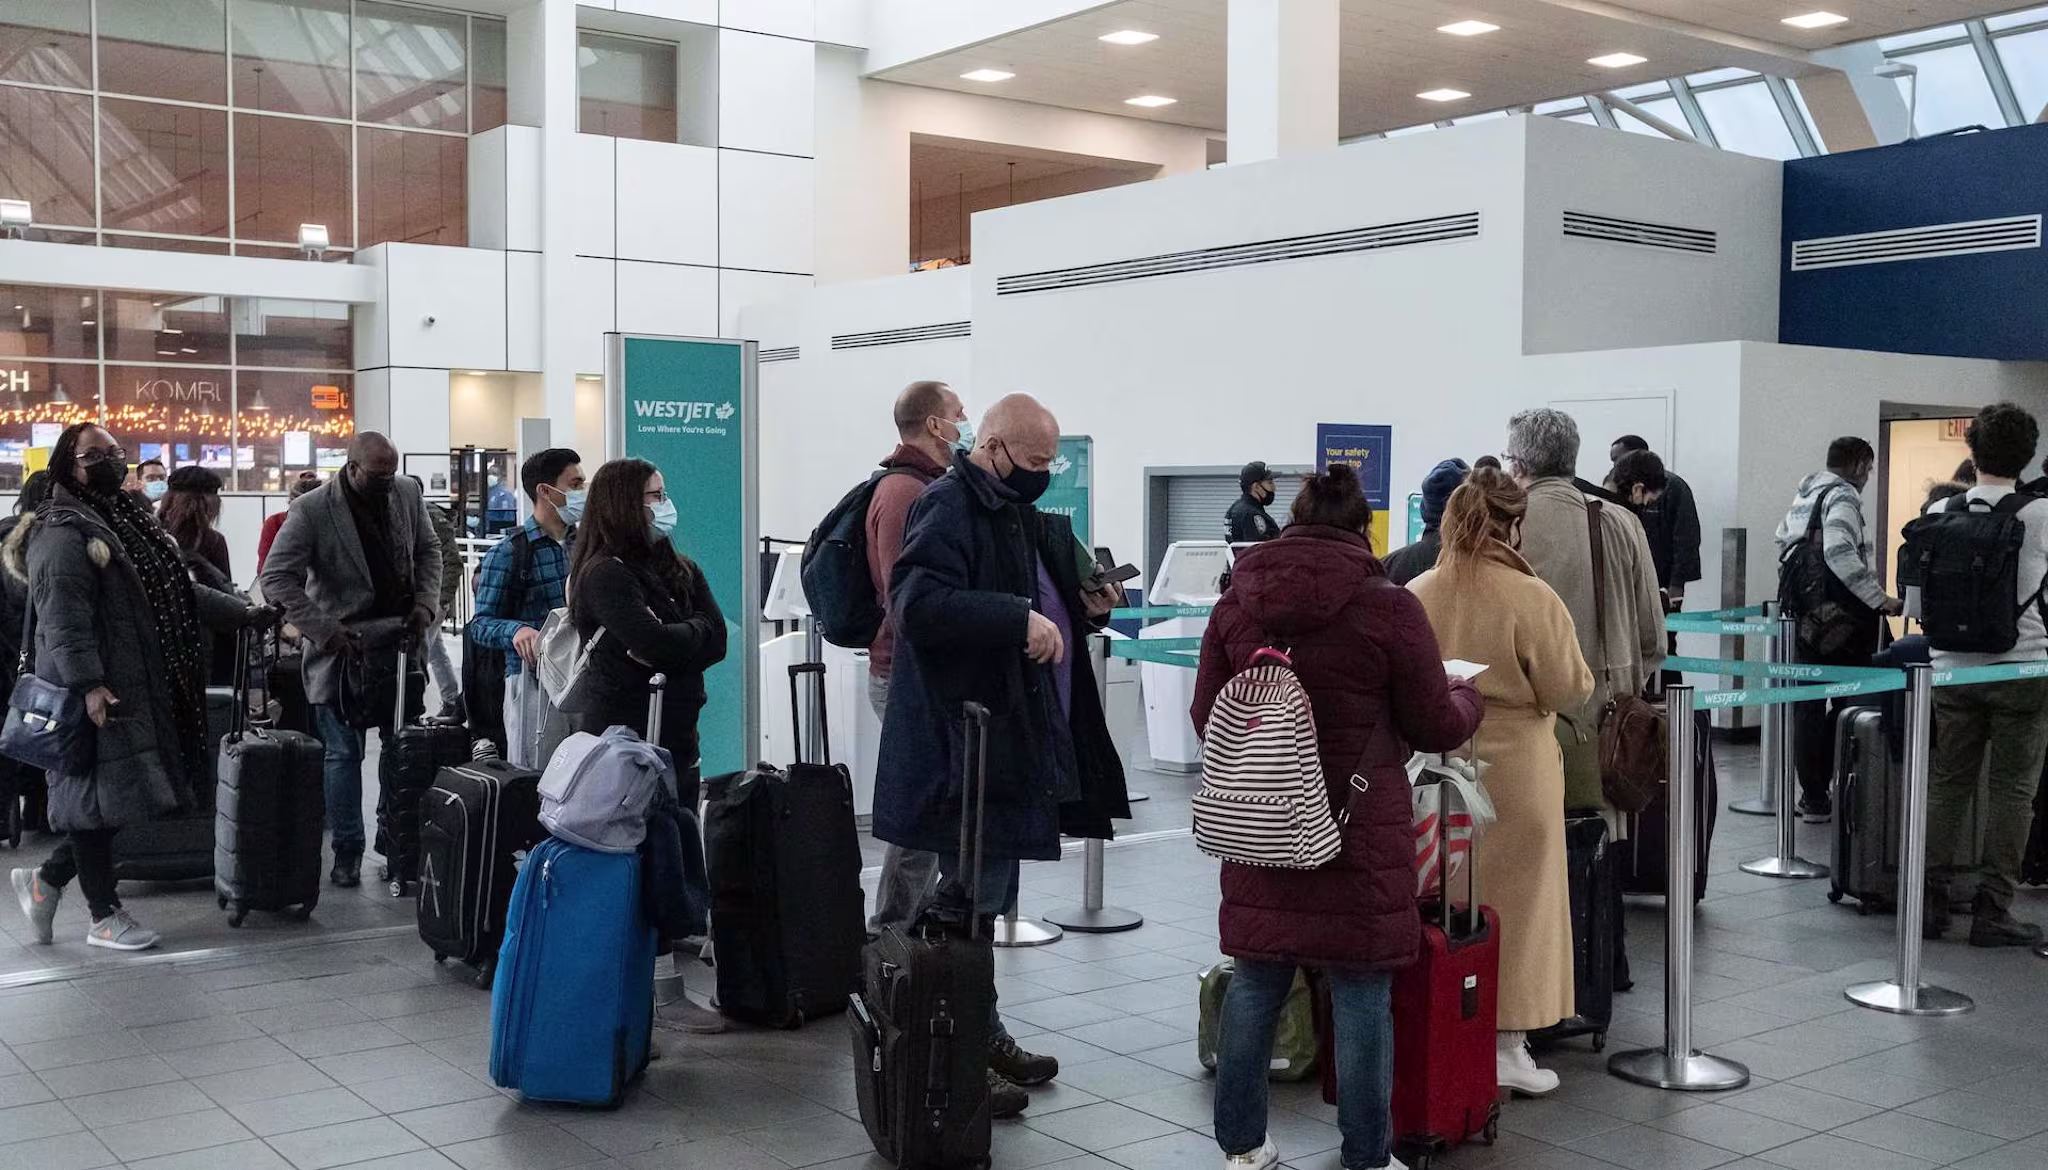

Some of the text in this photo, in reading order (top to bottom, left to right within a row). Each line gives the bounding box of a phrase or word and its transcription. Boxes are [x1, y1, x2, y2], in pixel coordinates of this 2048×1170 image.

[634, 400, 715, 424] WESTJET
[638, 425, 726, 436] Love Where You're Going
[1326, 448, 1370, 459] Your safety
[1176, 607, 1202, 616] WESTJET
[1722, 623, 1757, 632] WESTJET
[1768, 665, 1811, 678] WESTJET
[1704, 692, 1738, 705] WESTJET
